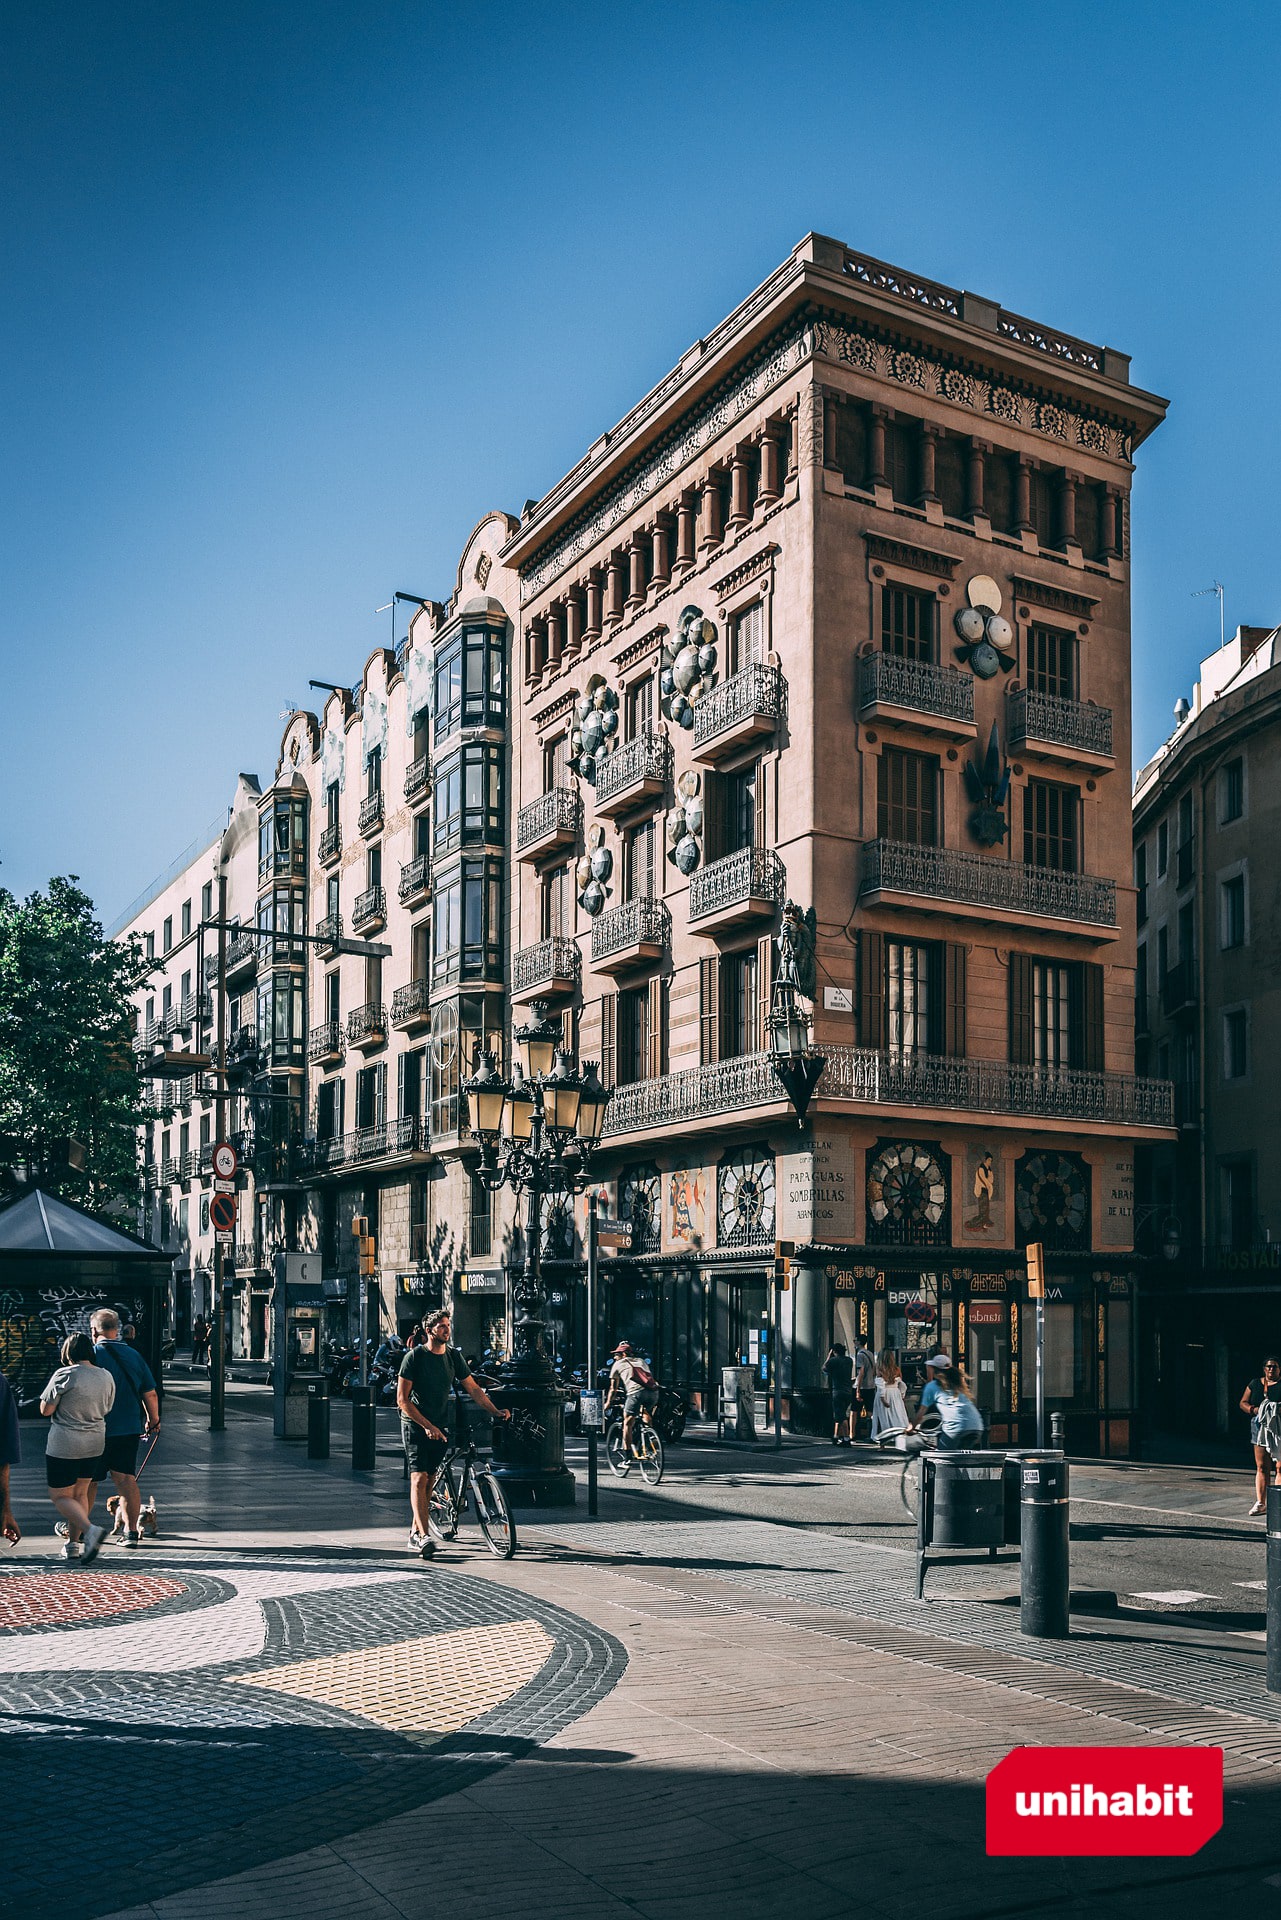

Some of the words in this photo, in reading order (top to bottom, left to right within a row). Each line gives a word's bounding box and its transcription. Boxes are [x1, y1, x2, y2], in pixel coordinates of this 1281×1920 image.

[807, 1141, 832, 1149] TELAN
[789, 1189, 845, 1202] SOMBRILLAS
[797, 1209, 834, 1219] ABANICOS
[1108, 1206, 1117, 1216] DE
[1216, 1250, 1280, 1270] HOSTAL
[468, 1273, 485, 1291] pans
[889, 1291, 923, 1304] BBVA
